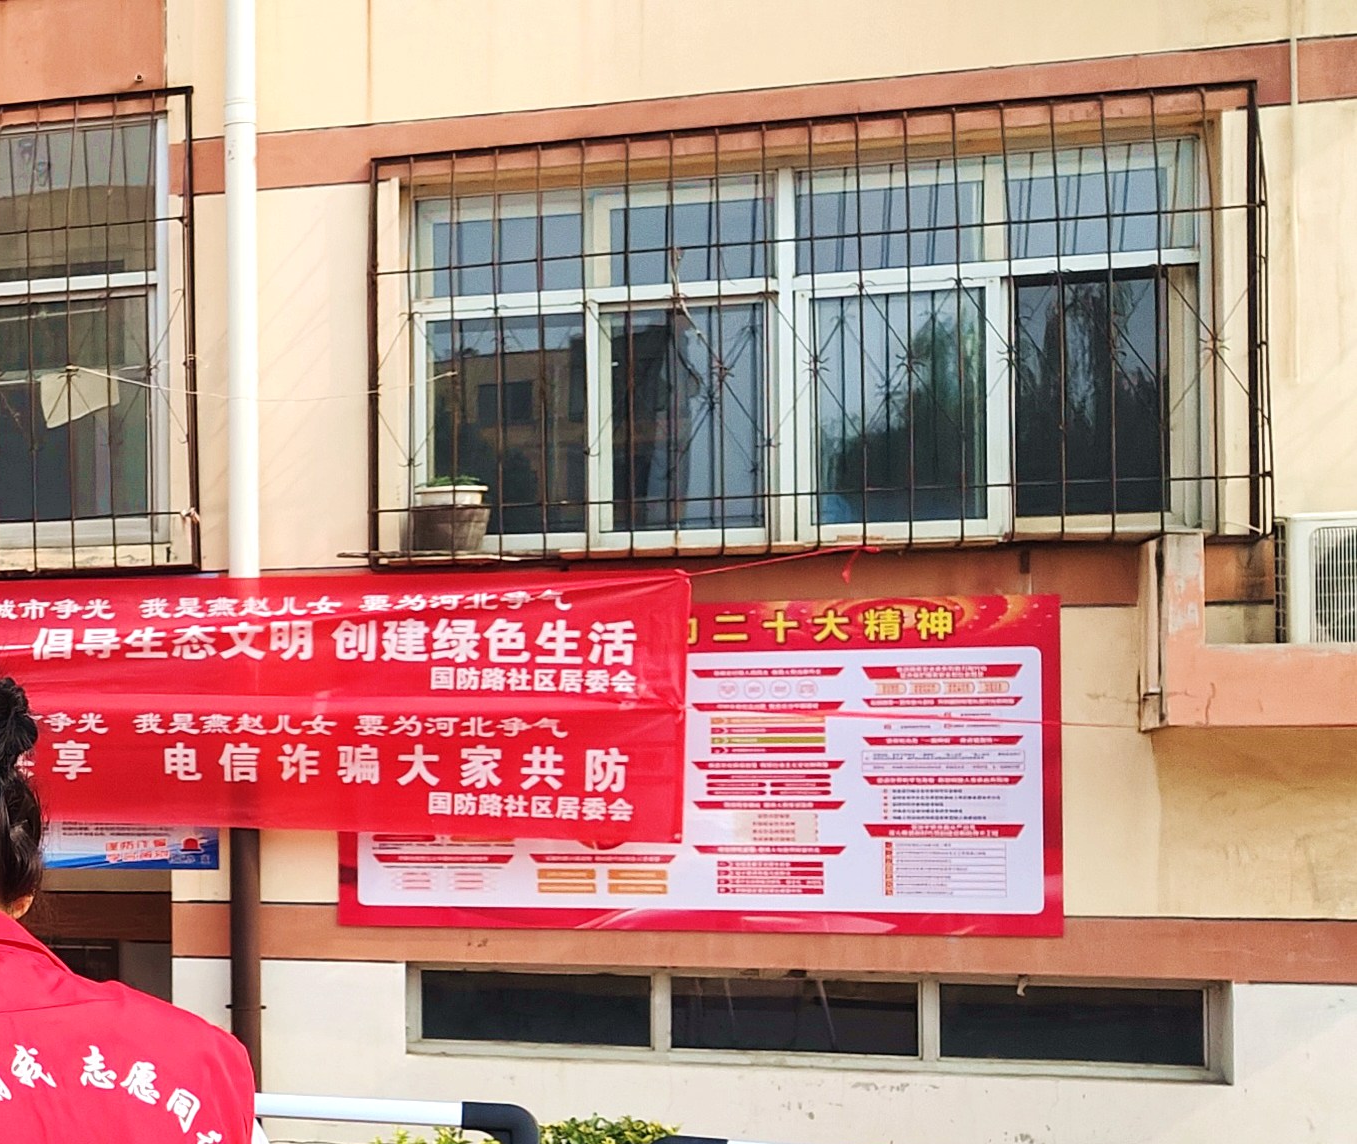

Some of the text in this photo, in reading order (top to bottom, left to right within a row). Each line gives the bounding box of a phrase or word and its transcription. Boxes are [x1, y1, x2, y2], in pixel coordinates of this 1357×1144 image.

[139, 595, 343, 619] 我是燕赵儿女
[359, 589, 573, 613] 要为河北争气
[331, 618, 638, 665] 创建绿色生活
[430, 667, 638, 693] 国防路社区居委会
[28, 712, 109, 735] 争光
[132, 712, 338, 736] 我是燕赵儿女
[353, 713, 569, 739] 要为河北争气
[163, 741, 629, 793] 电信诈骗大家共防
[427, 791, 635, 821] 国防路社区居委会
